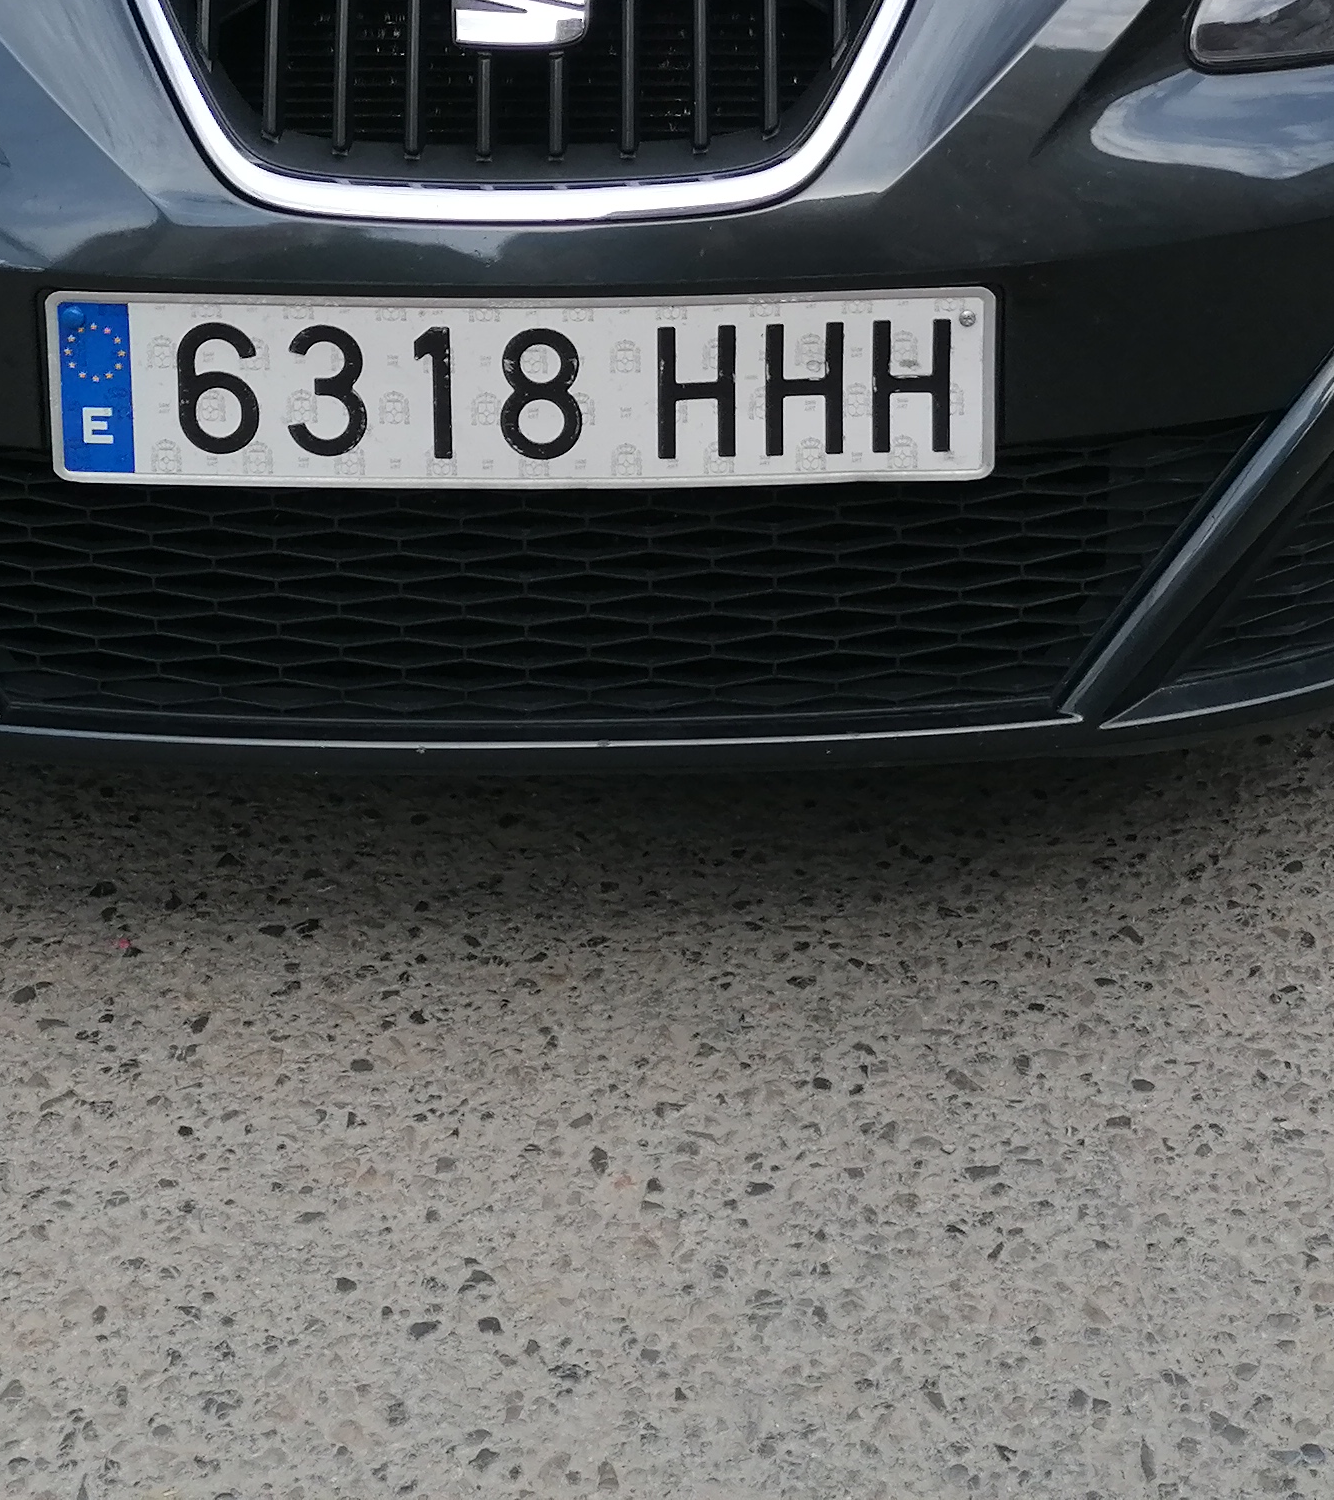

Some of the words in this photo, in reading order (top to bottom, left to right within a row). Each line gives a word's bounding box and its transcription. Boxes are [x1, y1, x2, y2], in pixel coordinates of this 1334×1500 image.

[82, 406, 114, 444] E
[176, 321, 583, 461] 6318
[657, 318, 952, 460] HHH
